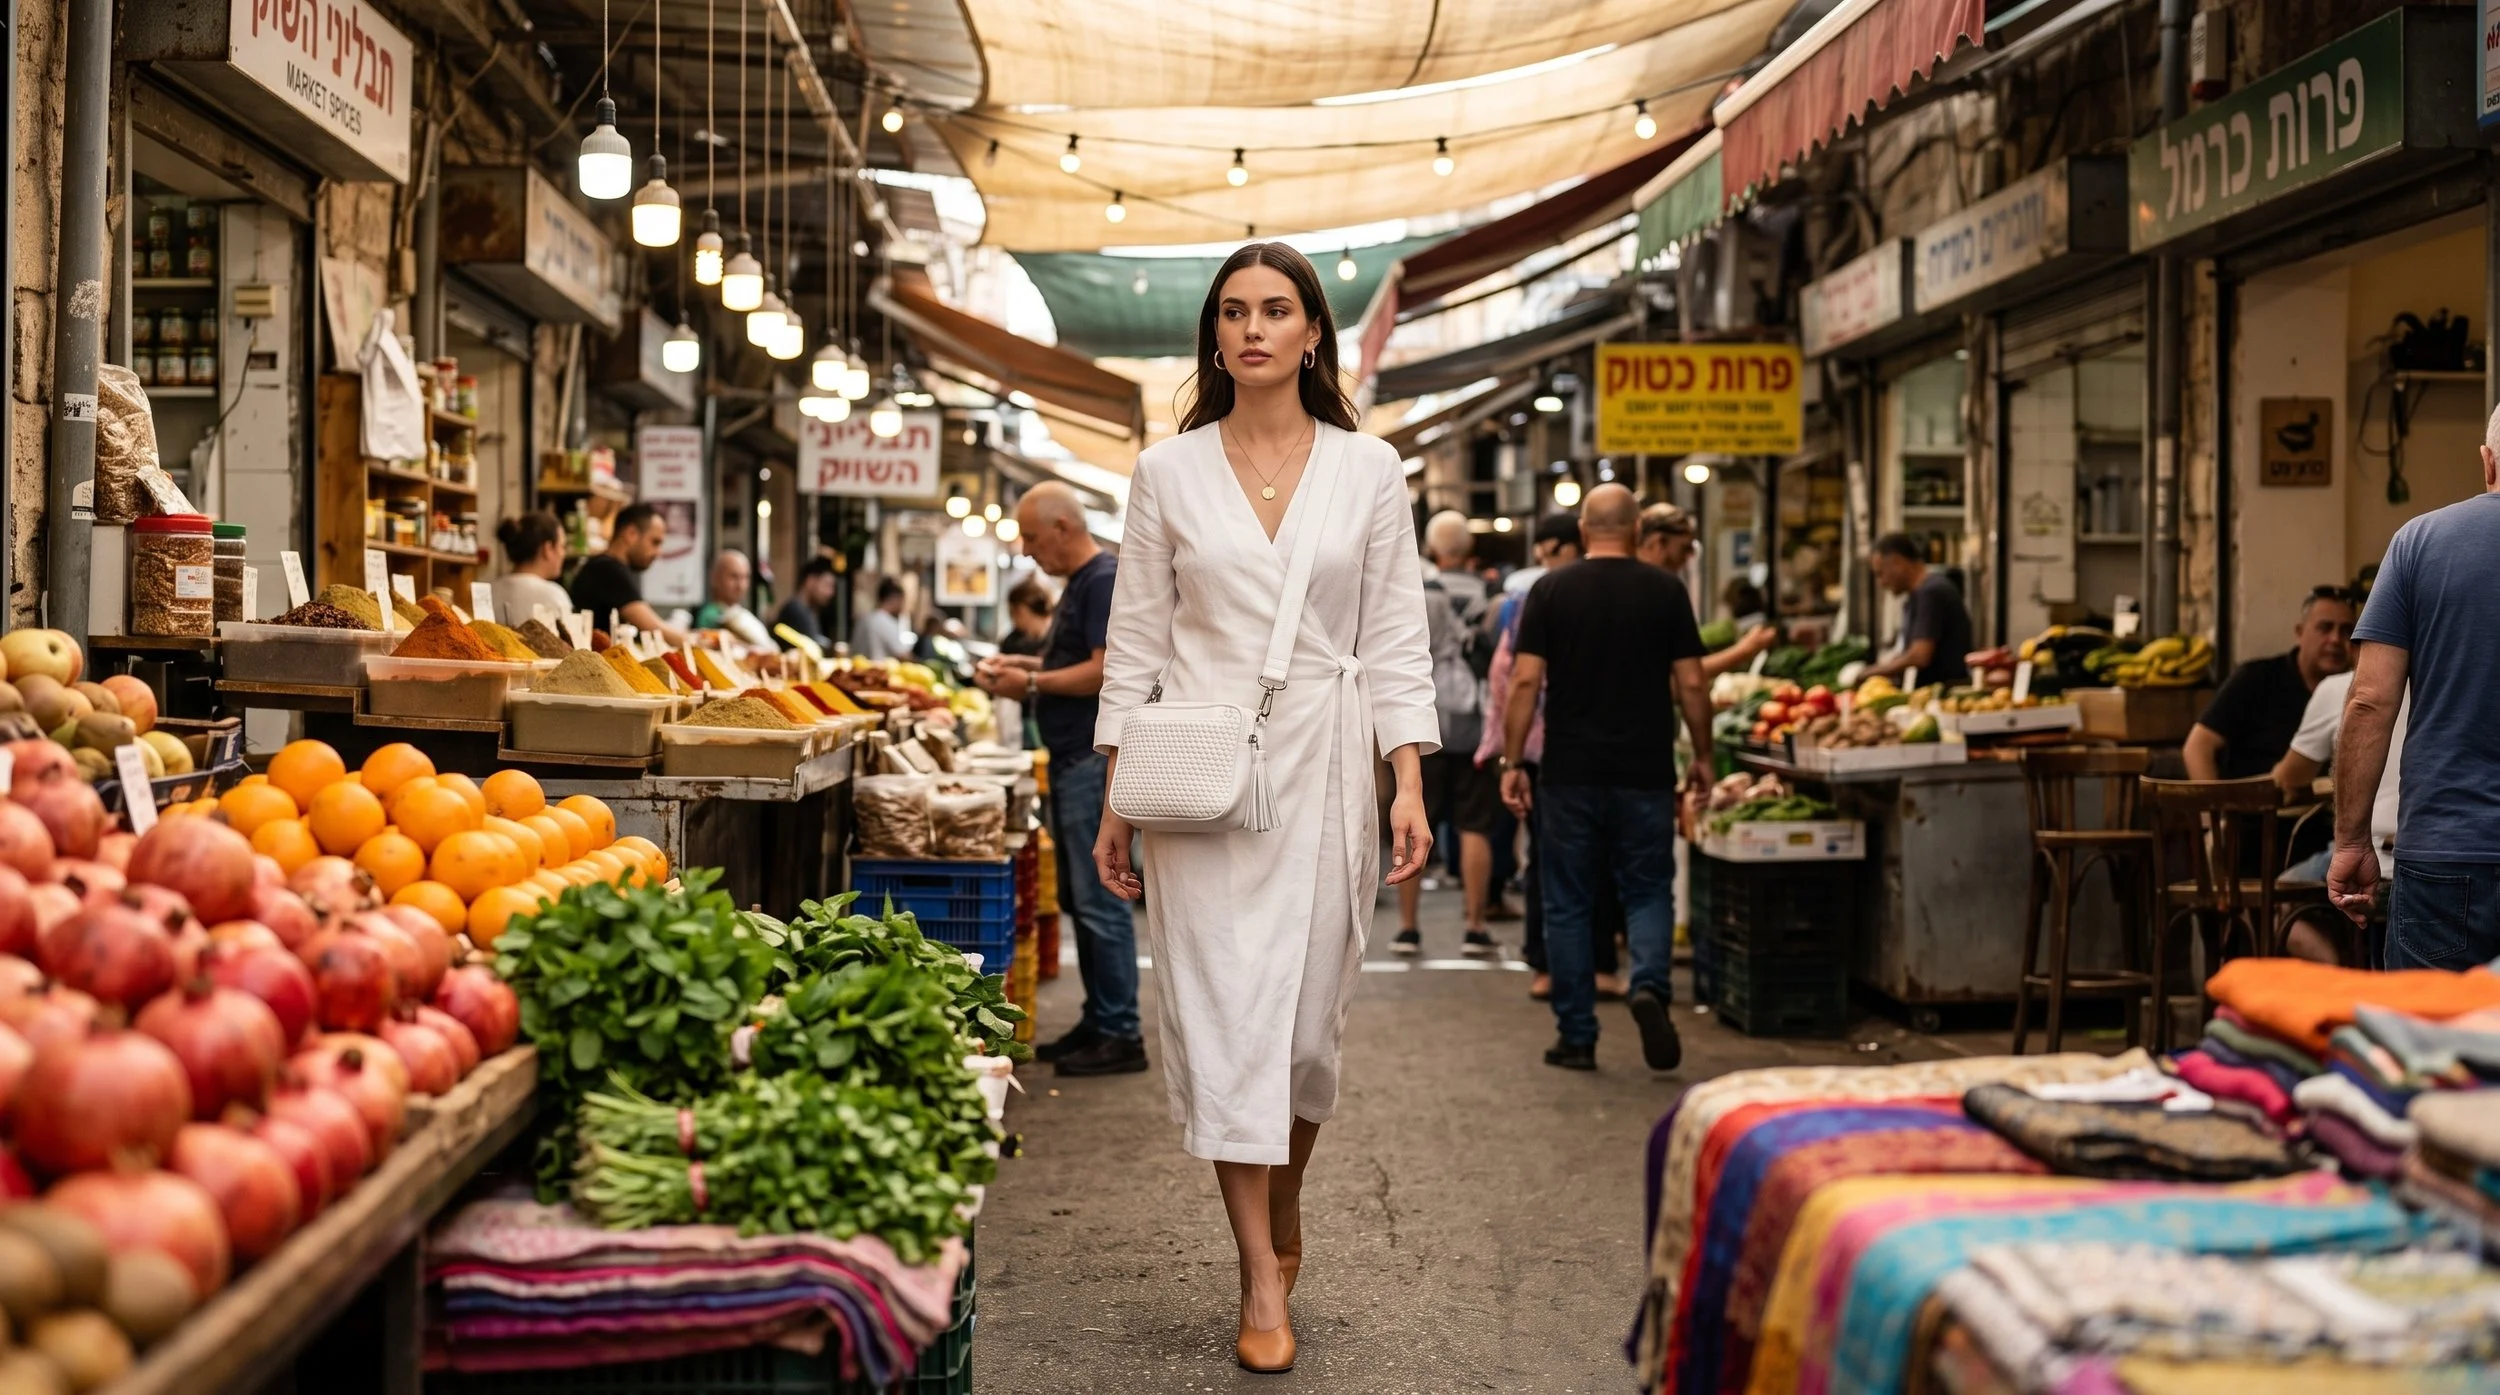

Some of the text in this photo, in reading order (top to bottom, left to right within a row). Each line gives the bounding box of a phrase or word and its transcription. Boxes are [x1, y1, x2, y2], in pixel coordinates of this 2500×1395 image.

[286, 60, 363, 136] MARKET SPICES
[326, 3, 394, 117] תבליני
[2160, 57, 2365, 222] פרות כרמל
[1606, 356, 1793, 399] פרות כטוק
